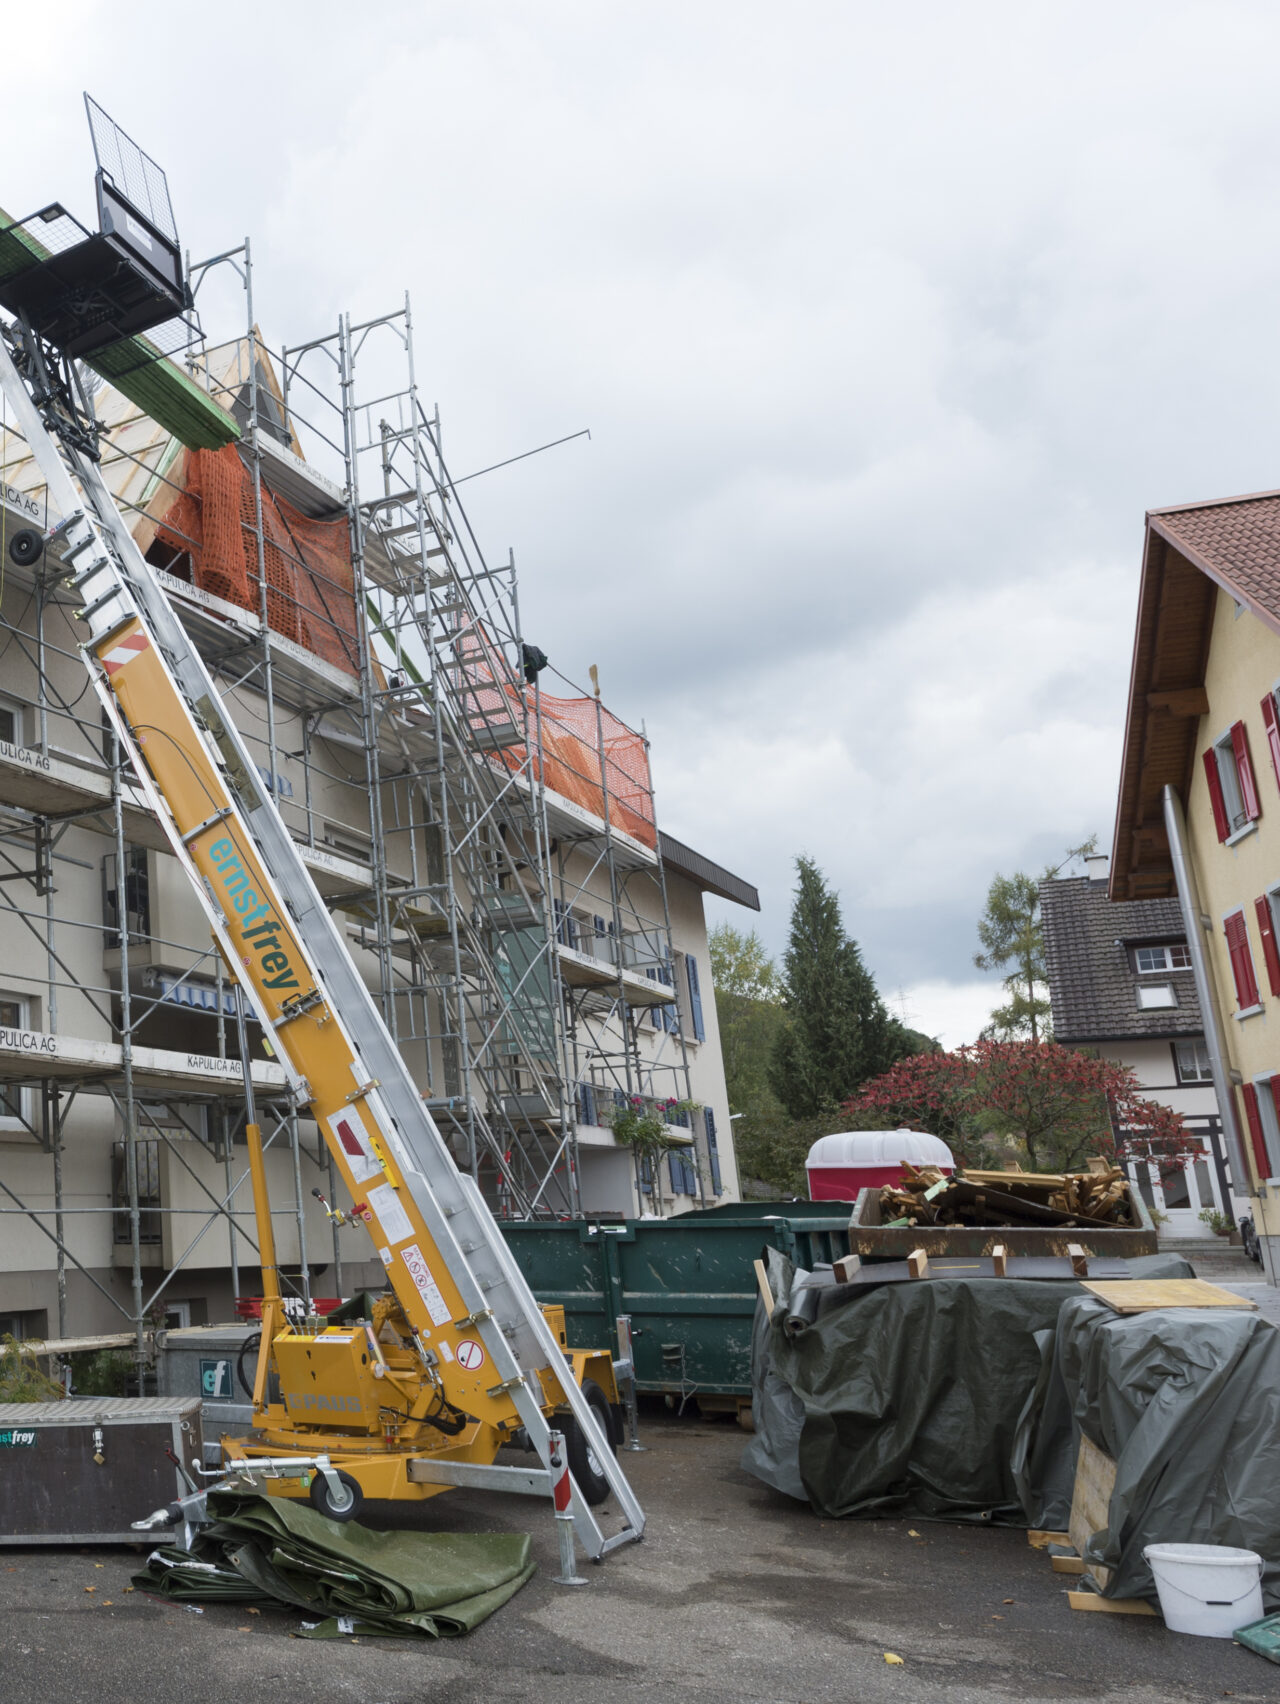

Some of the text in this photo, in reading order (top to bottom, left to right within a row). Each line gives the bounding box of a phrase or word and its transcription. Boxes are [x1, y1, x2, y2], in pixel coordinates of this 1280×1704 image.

[24, 499, 39, 516] AG
[155, 567, 197, 598] KAPULICA
[35, 755, 50, 771] AG
[40, 1036, 57, 1053] AG
[187, 1055, 242, 1074] KAPULICA AG
